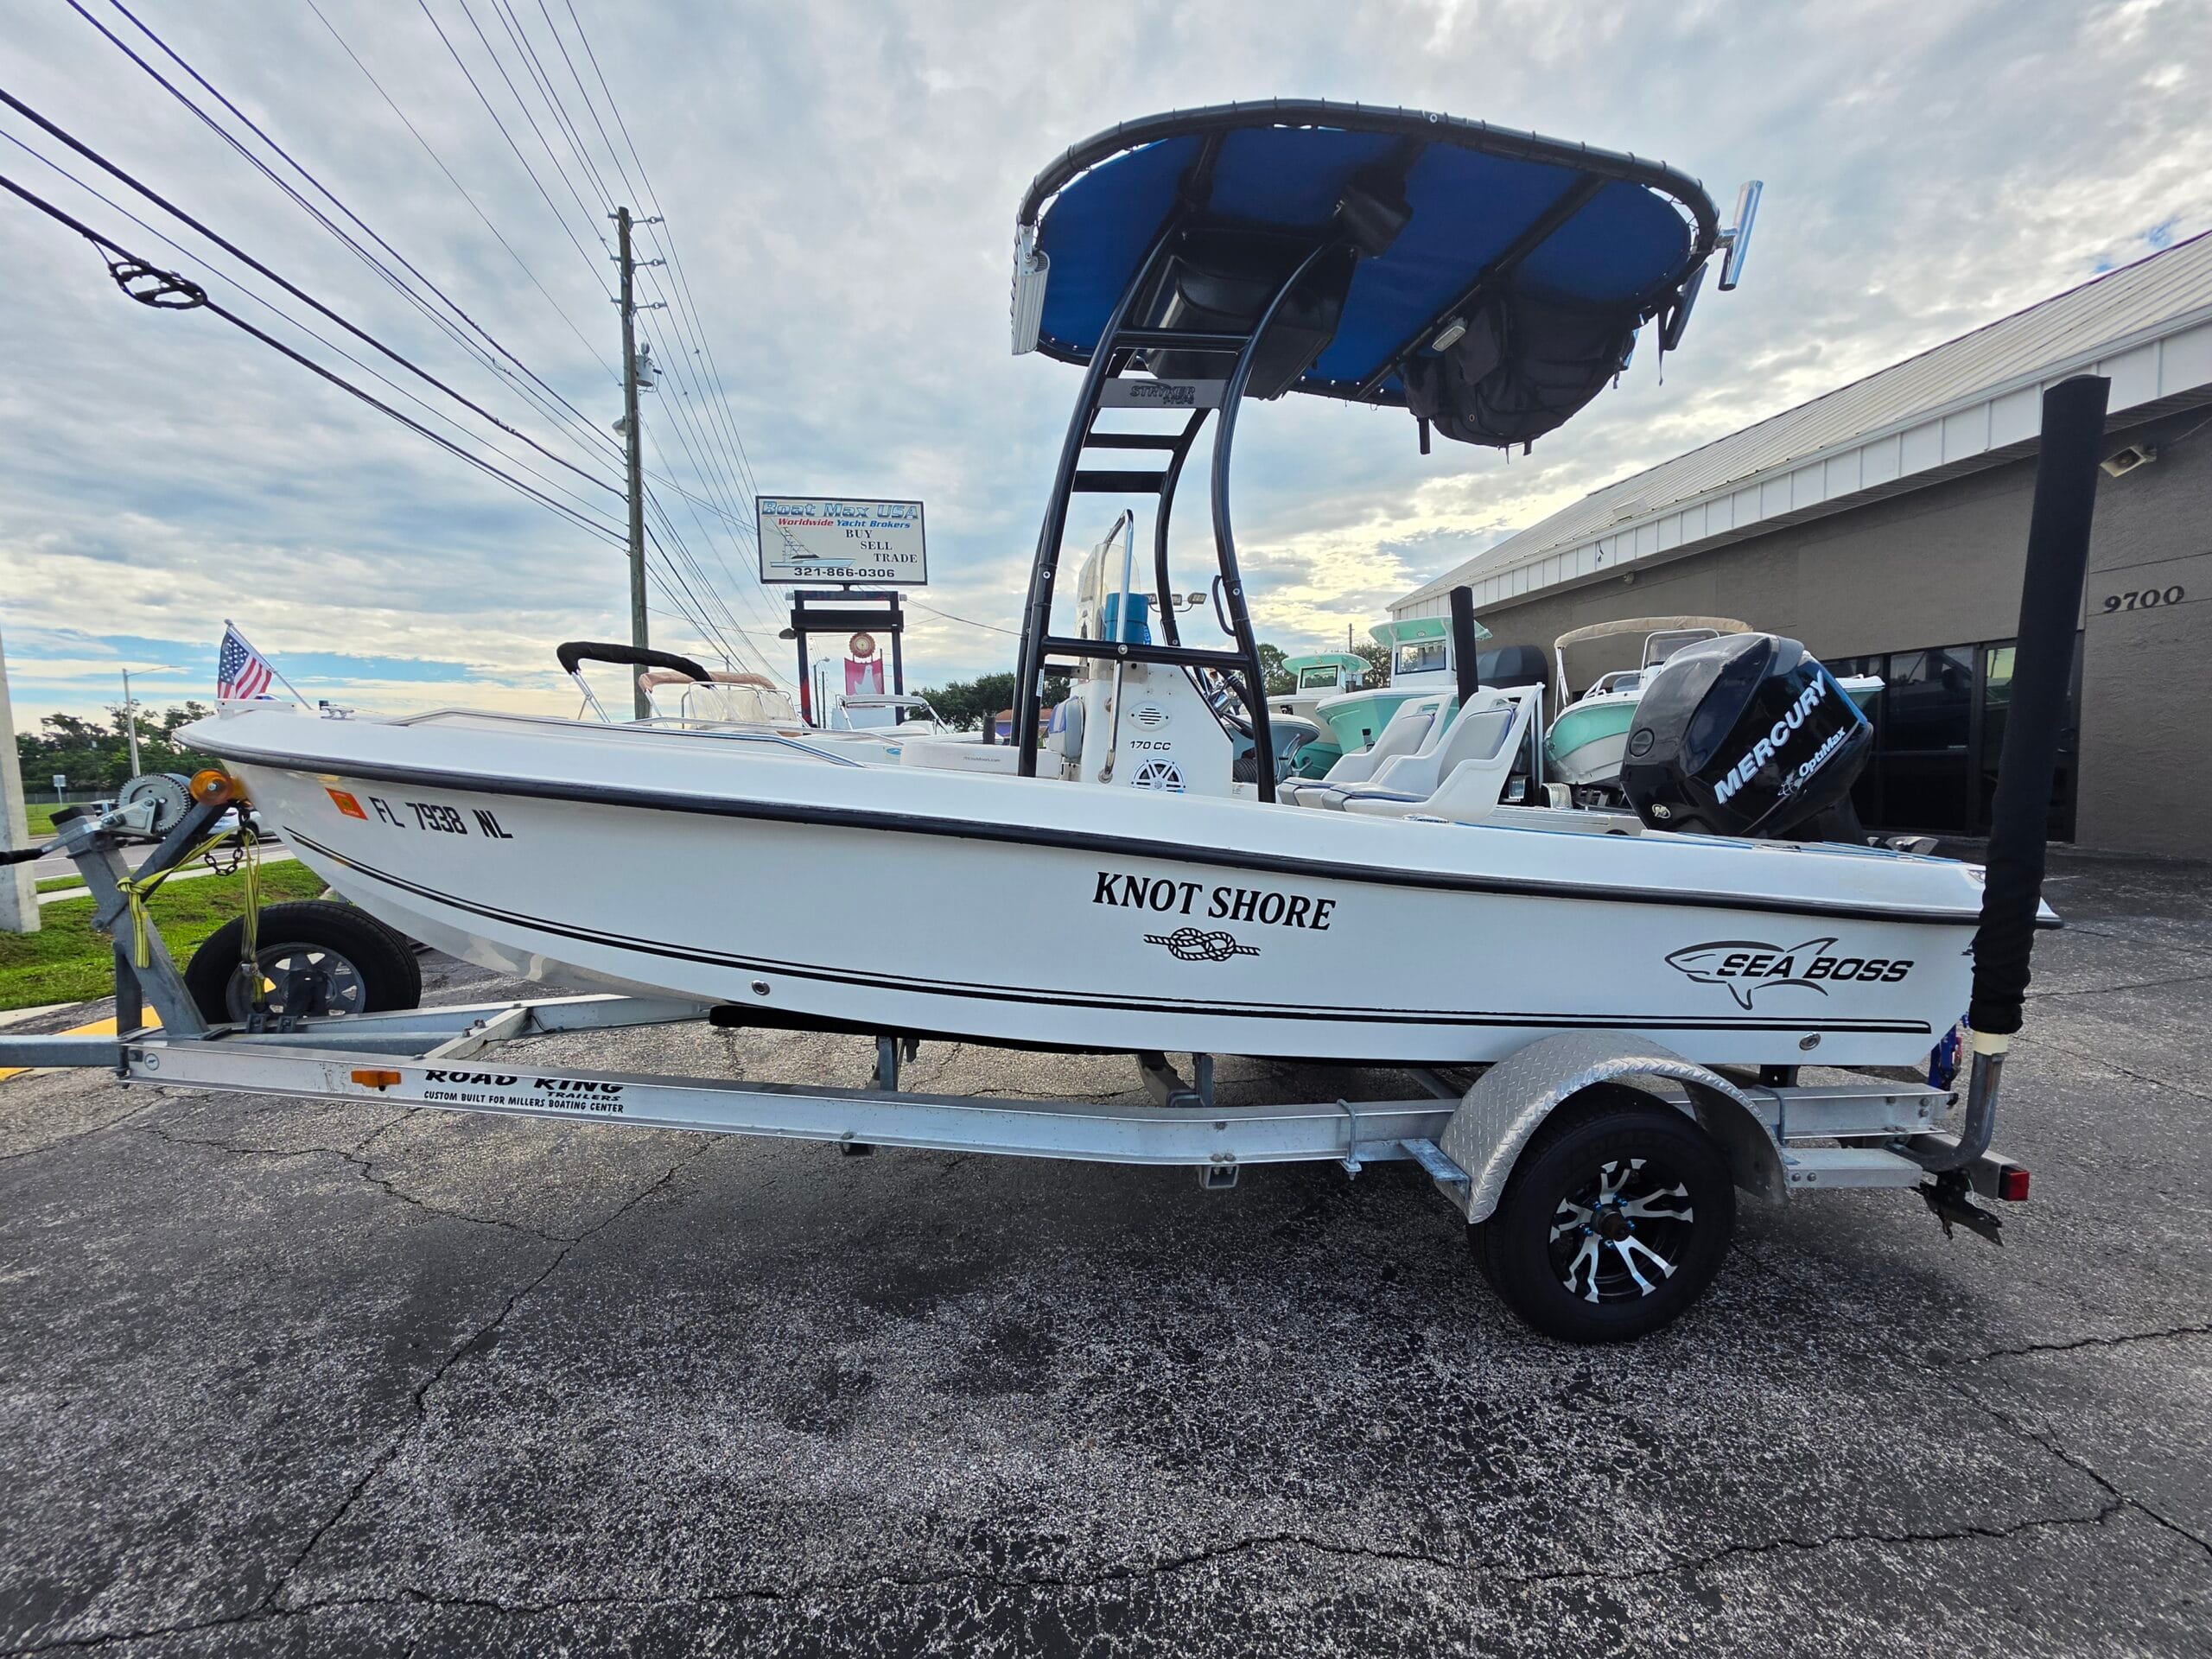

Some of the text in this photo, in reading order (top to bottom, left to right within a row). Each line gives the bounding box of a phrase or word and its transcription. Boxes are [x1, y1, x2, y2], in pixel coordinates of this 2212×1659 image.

[761, 500, 918, 519] Boat Max USA
[778, 518, 911, 529] Worldwide Yacht Brokers
[845, 529, 873, 538] BUY
[860, 541, 893, 550] SELL
[874, 553, 918, 563] TRADE
[794, 567, 895, 577] 321-866-0306
[2103, 585, 2184, 613] 9700
[1130, 741, 1171, 750] 170 CC
[1713, 669, 1827, 804] MERCURY
[1798, 726, 1847, 778] OptiMax
[368, 796, 514, 839] FL 7938 NL
[1092, 871, 1337, 931] KNOT SHORE
[1716, 953, 1915, 982] SEA BOSS
[425, 1070, 624, 1094] ROAD KING
[423, 1090, 624, 1114] CUSTOM BUILT FOR MILLERS BOATING CENTER
[546, 1091, 621, 1102] TRAILERS
